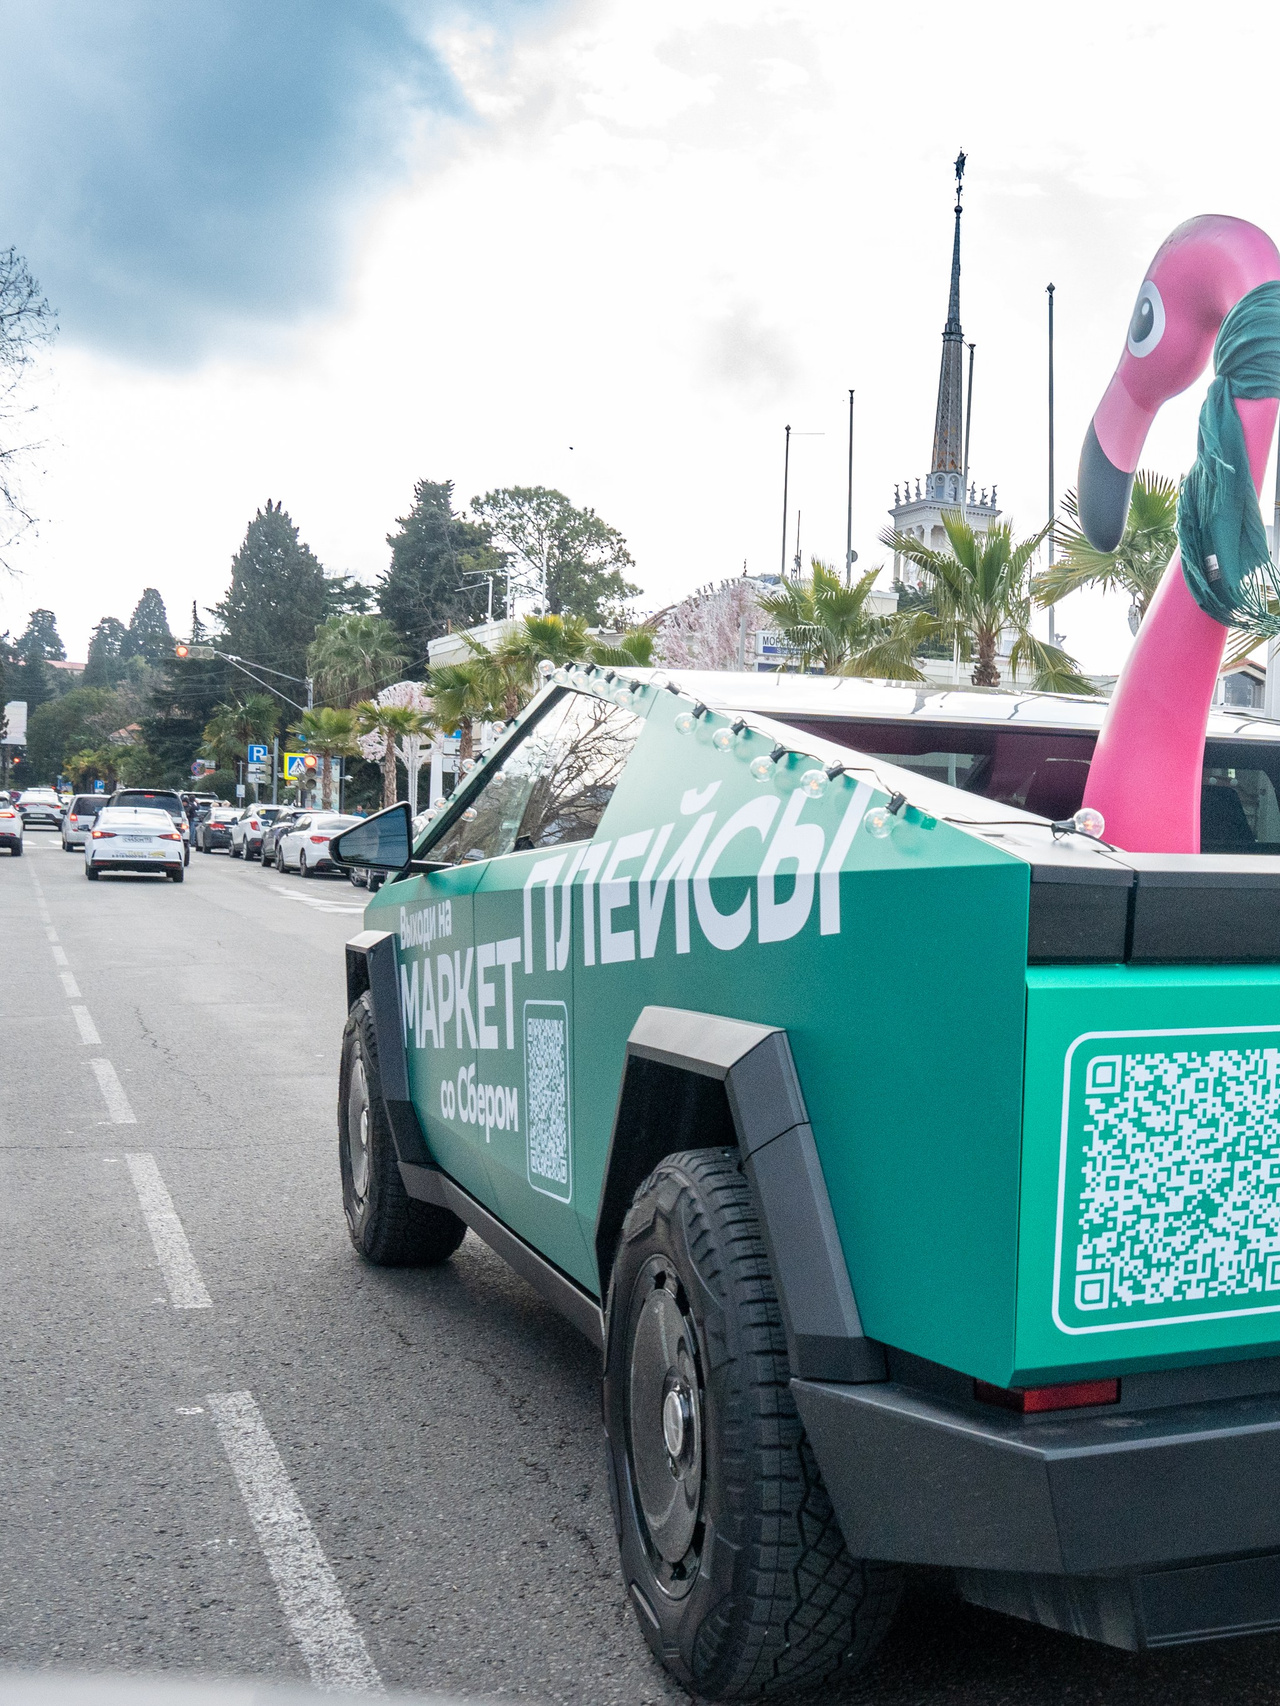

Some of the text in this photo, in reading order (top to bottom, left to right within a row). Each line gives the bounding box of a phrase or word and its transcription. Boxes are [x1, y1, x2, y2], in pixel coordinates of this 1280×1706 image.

[523, 779, 874, 974] ПЛЕЙСЫ
[400, 900, 452, 951] Выходи на
[401, 937, 521, 1050] МАРКЕТ
[441, 1063, 518, 1143] со Сбером
